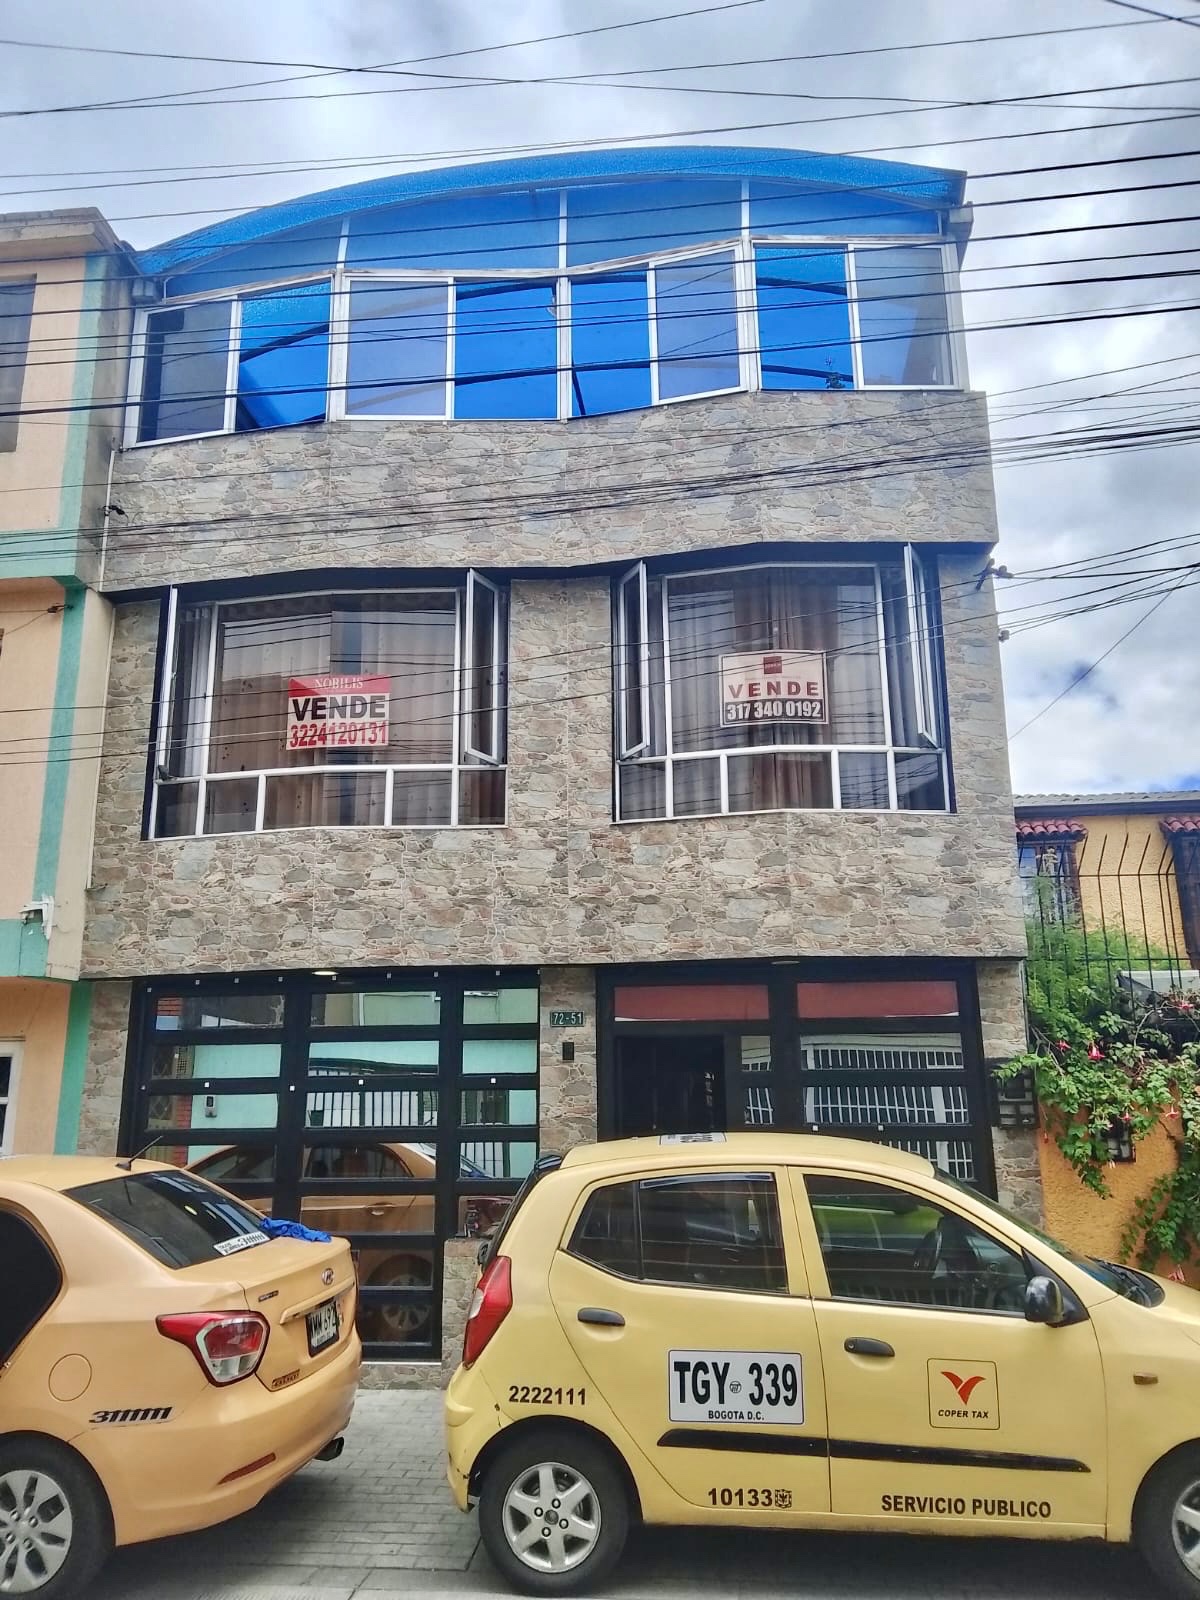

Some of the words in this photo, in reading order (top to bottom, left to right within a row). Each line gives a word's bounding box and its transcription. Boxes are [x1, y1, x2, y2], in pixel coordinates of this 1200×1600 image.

[314, 676, 364, 689] NOBILIS
[729, 681, 819, 698] VENDE
[292, 695, 386, 721] VENDE
[727, 703, 751, 720] 317
[754, 701, 783, 718] 340
[785, 700, 821, 717] 0192
[289, 720, 386, 748] 3224120131
[553, 1012, 583, 1026] 72-51
[673, 1361, 730, 1405] TGY
[748, 1362, 798, 1407] 339
[508, 1385, 586, 1405] 2222111
[708, 1410, 744, 1420] BOGOTA
[747, 1411, 765, 1420] D.C.
[938, 1409, 969, 1418] COPER
[971, 1410, 989, 1419] TAX
[708, 1487, 773, 1507] 10133
[881, 1494, 966, 1515] SERVICIO
[972, 1498, 1052, 1518] PUBLICO
